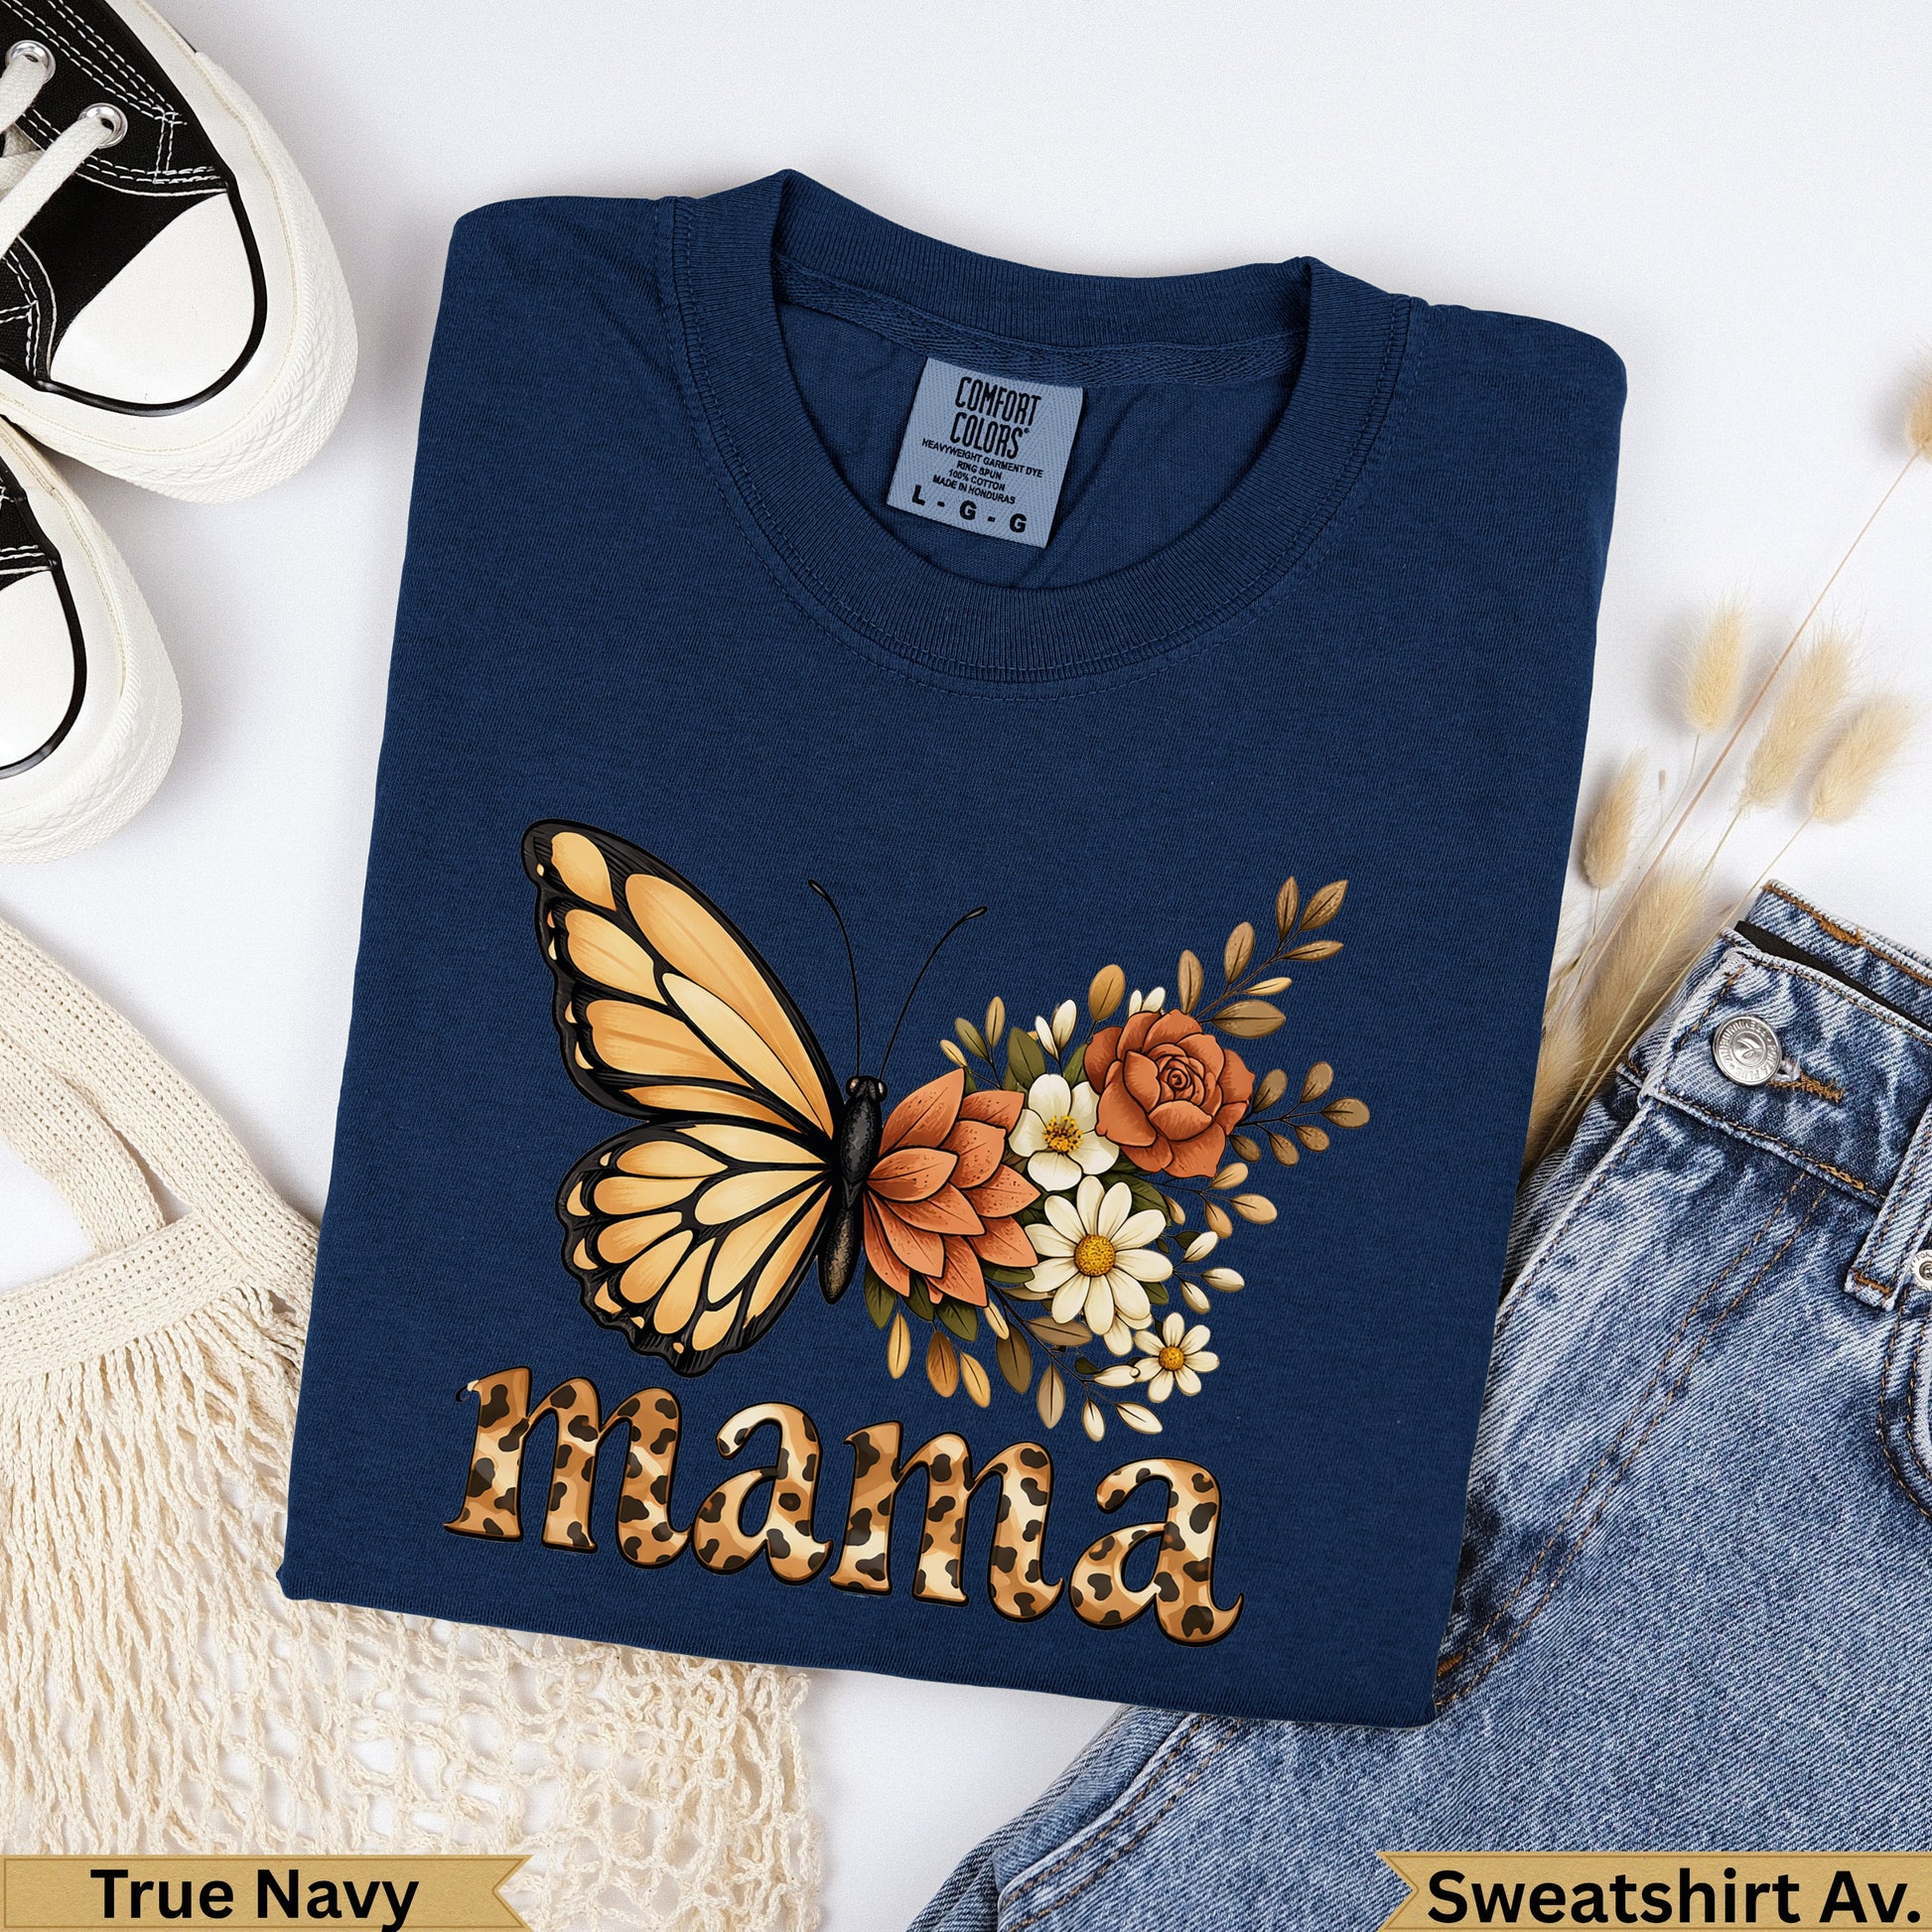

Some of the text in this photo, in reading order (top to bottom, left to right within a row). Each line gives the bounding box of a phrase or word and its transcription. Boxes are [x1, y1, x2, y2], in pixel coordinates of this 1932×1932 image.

[955, 376, 1041, 426] COMFORT
[922, 438, 1043, 479] HEAVYWEIGHT GARMENT DYE
[956, 461, 1003, 481] RING SPUN
[932, 475, 1017, 505] MADE IN HONDURAS
[949, 469, 1006, 491] 100% COTTON
[911, 484, 926, 506] L
[959, 500, 978, 521] G
[1009, 513, 1028, 533] G
[444, 1366, 1243, 1645] mama
